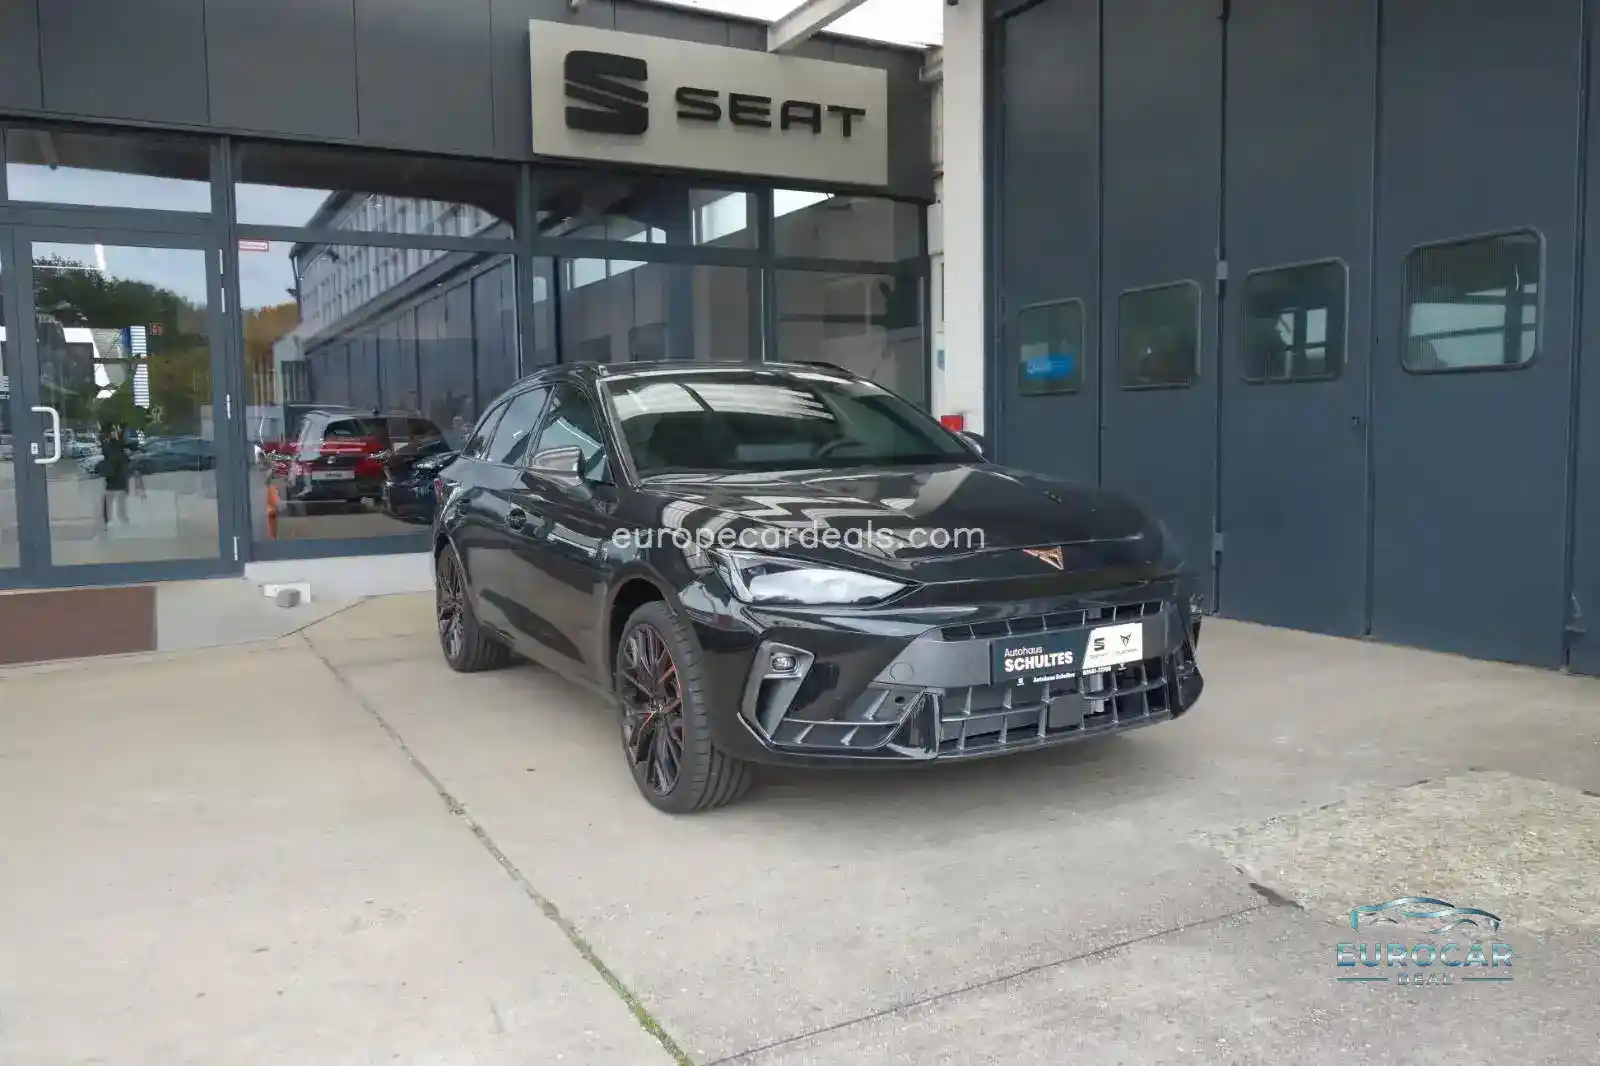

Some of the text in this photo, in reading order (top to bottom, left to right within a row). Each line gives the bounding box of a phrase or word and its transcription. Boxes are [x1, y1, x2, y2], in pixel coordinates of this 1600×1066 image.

[675, 86, 866, 138] SEAT
[1004, 646, 1043, 657] Autohaus
[1004, 651, 1073, 672] SCHULTES
